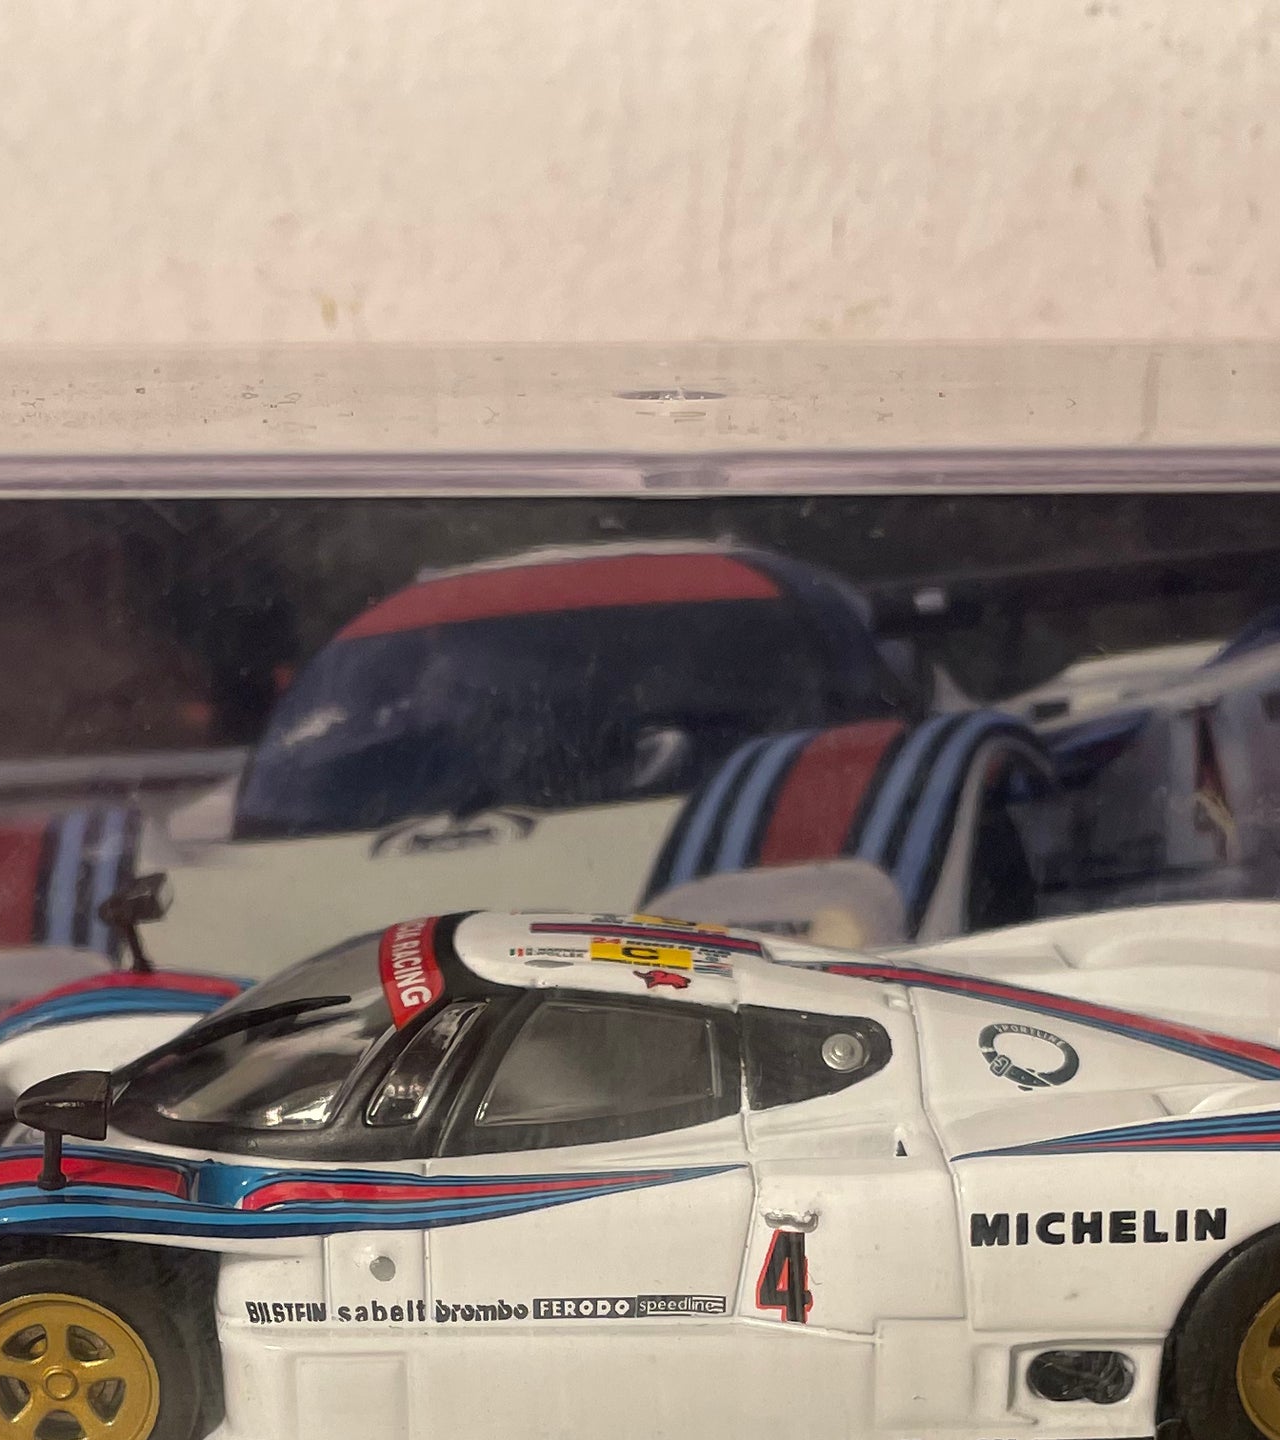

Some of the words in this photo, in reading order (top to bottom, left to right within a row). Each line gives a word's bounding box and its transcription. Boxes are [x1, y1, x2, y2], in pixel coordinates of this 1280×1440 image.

[391, 940, 433, 1008] RACING
[970, 1207, 1227, 1247] MICHELIN
[755, 1228, 814, 1325] 4
[337, 1300, 426, 1323] sabelt
[539, 1299, 630, 1317] FERODO
[638, 1296, 725, 1316] speedline
